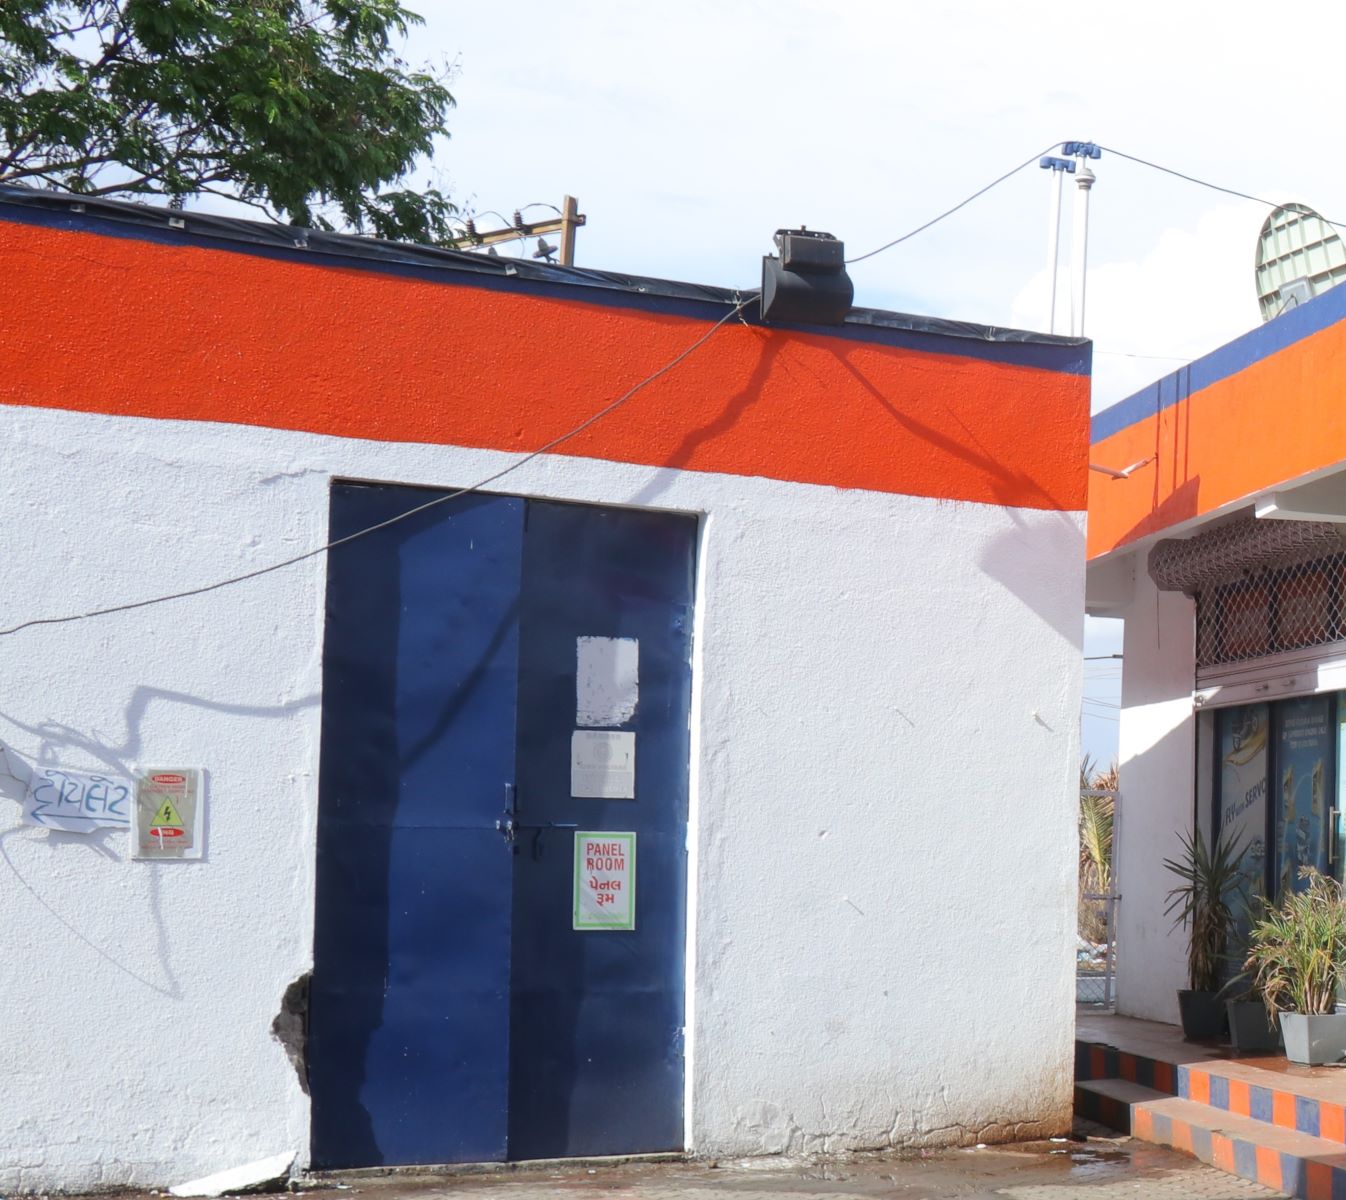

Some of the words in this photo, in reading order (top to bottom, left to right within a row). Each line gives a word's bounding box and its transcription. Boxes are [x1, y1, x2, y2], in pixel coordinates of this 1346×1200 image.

[587, 843, 624, 856] PANEL
[587, 858, 624, 871] ROOM
[590, 876, 621, 890] પેનલ
[597, 893, 614, 906] રૂમ
